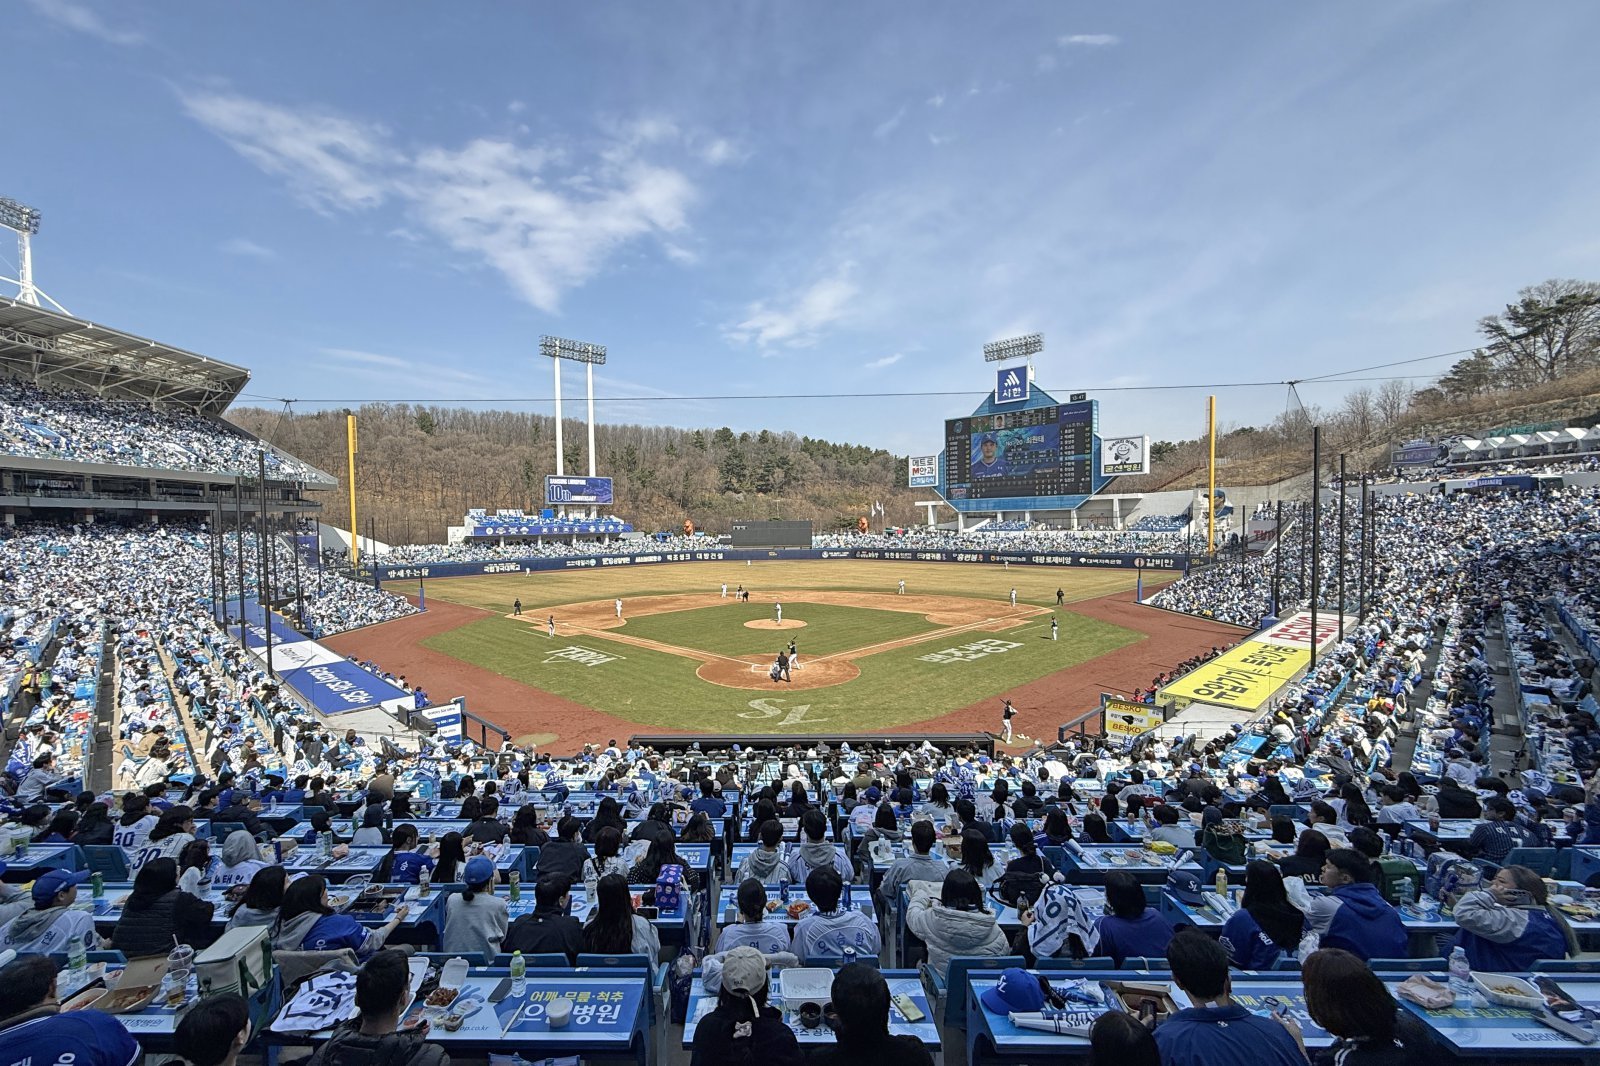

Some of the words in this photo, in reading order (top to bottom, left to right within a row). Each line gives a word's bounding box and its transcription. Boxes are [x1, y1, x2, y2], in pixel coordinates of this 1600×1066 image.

[912, 458, 934, 466] 메트로
[912, 467, 934, 475] M안과
[550, 485, 572, 501] 10th
[1112, 703, 1142, 713] BESKO
[1112, 723, 1142, 734] BESKO
[113, 832, 135, 848] 30
[518, 1004, 621, 1025] 으병원
